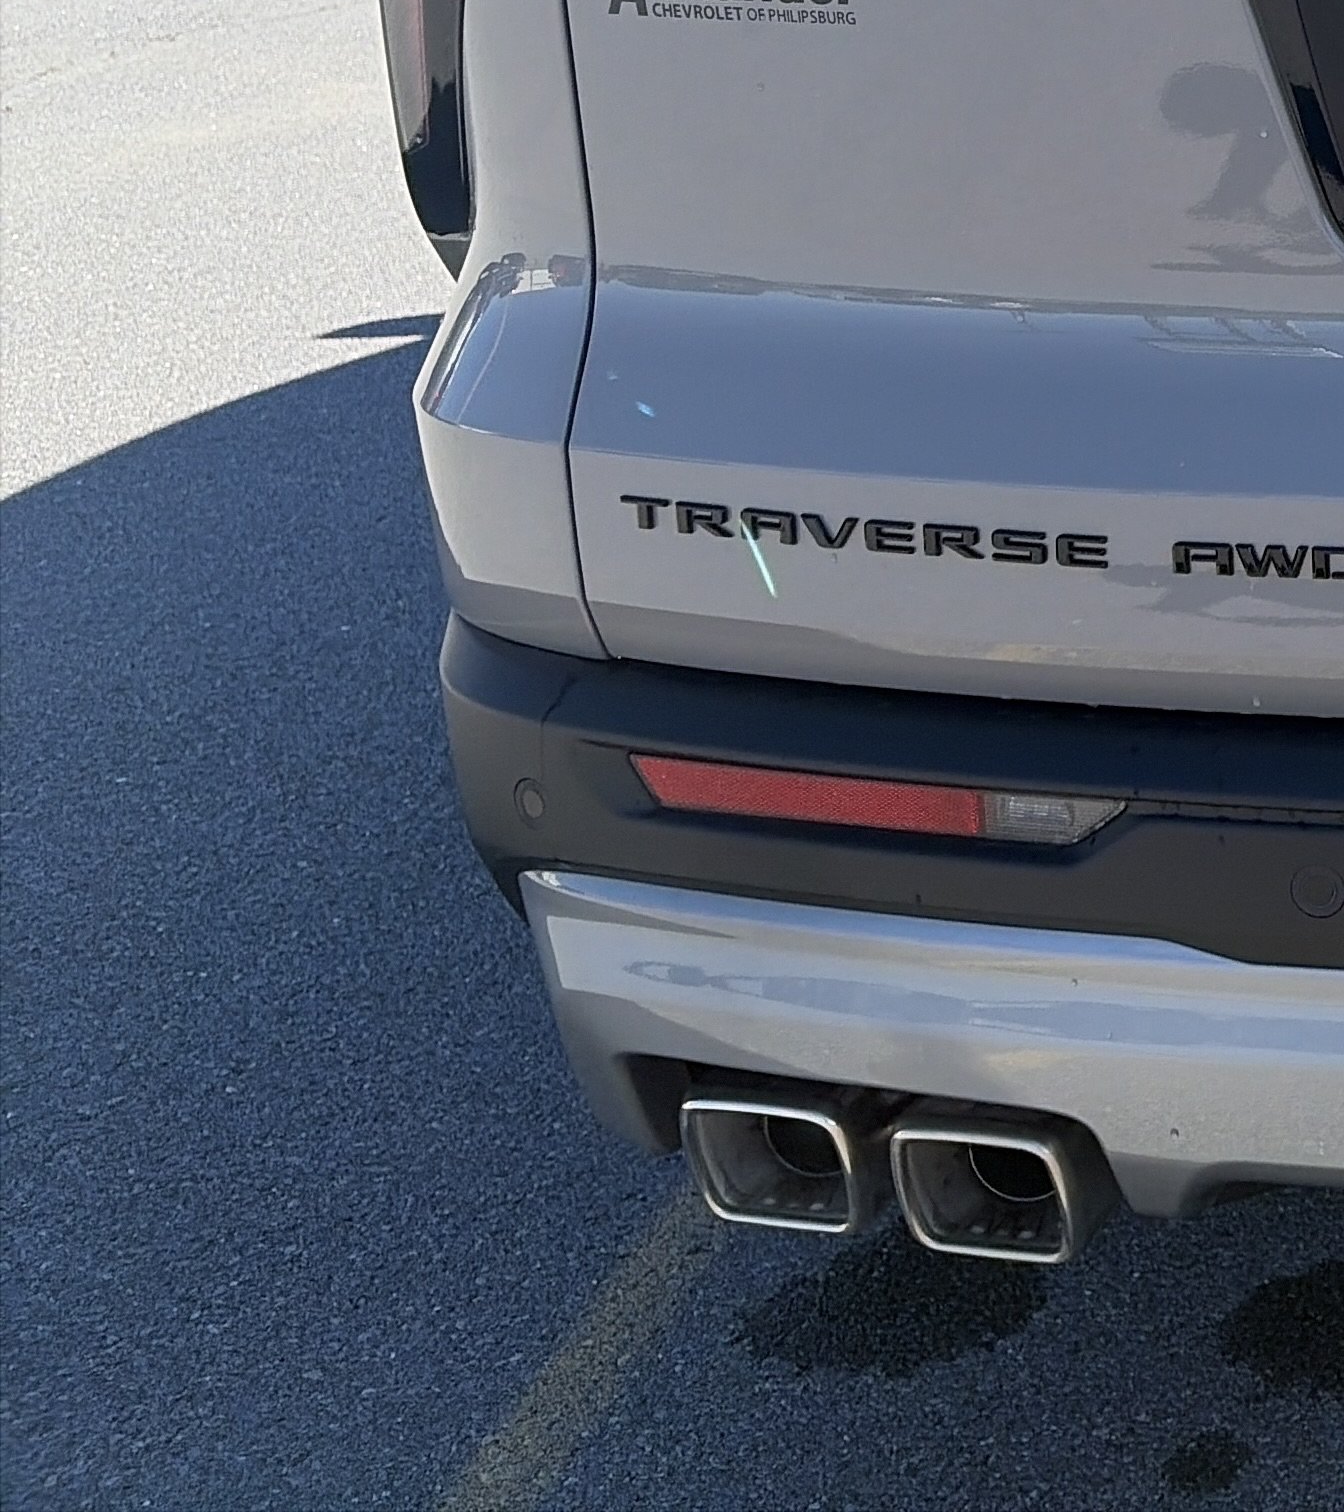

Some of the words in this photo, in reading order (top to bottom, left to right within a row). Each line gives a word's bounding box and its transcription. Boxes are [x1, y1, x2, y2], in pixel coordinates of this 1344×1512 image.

[652, 2, 743, 21] CHEVROLET
[746, 7, 766, 21] OF
[768, 9, 857, 25] PHILIPSBURG
[620, 494, 1108, 568] TRAVERSE
